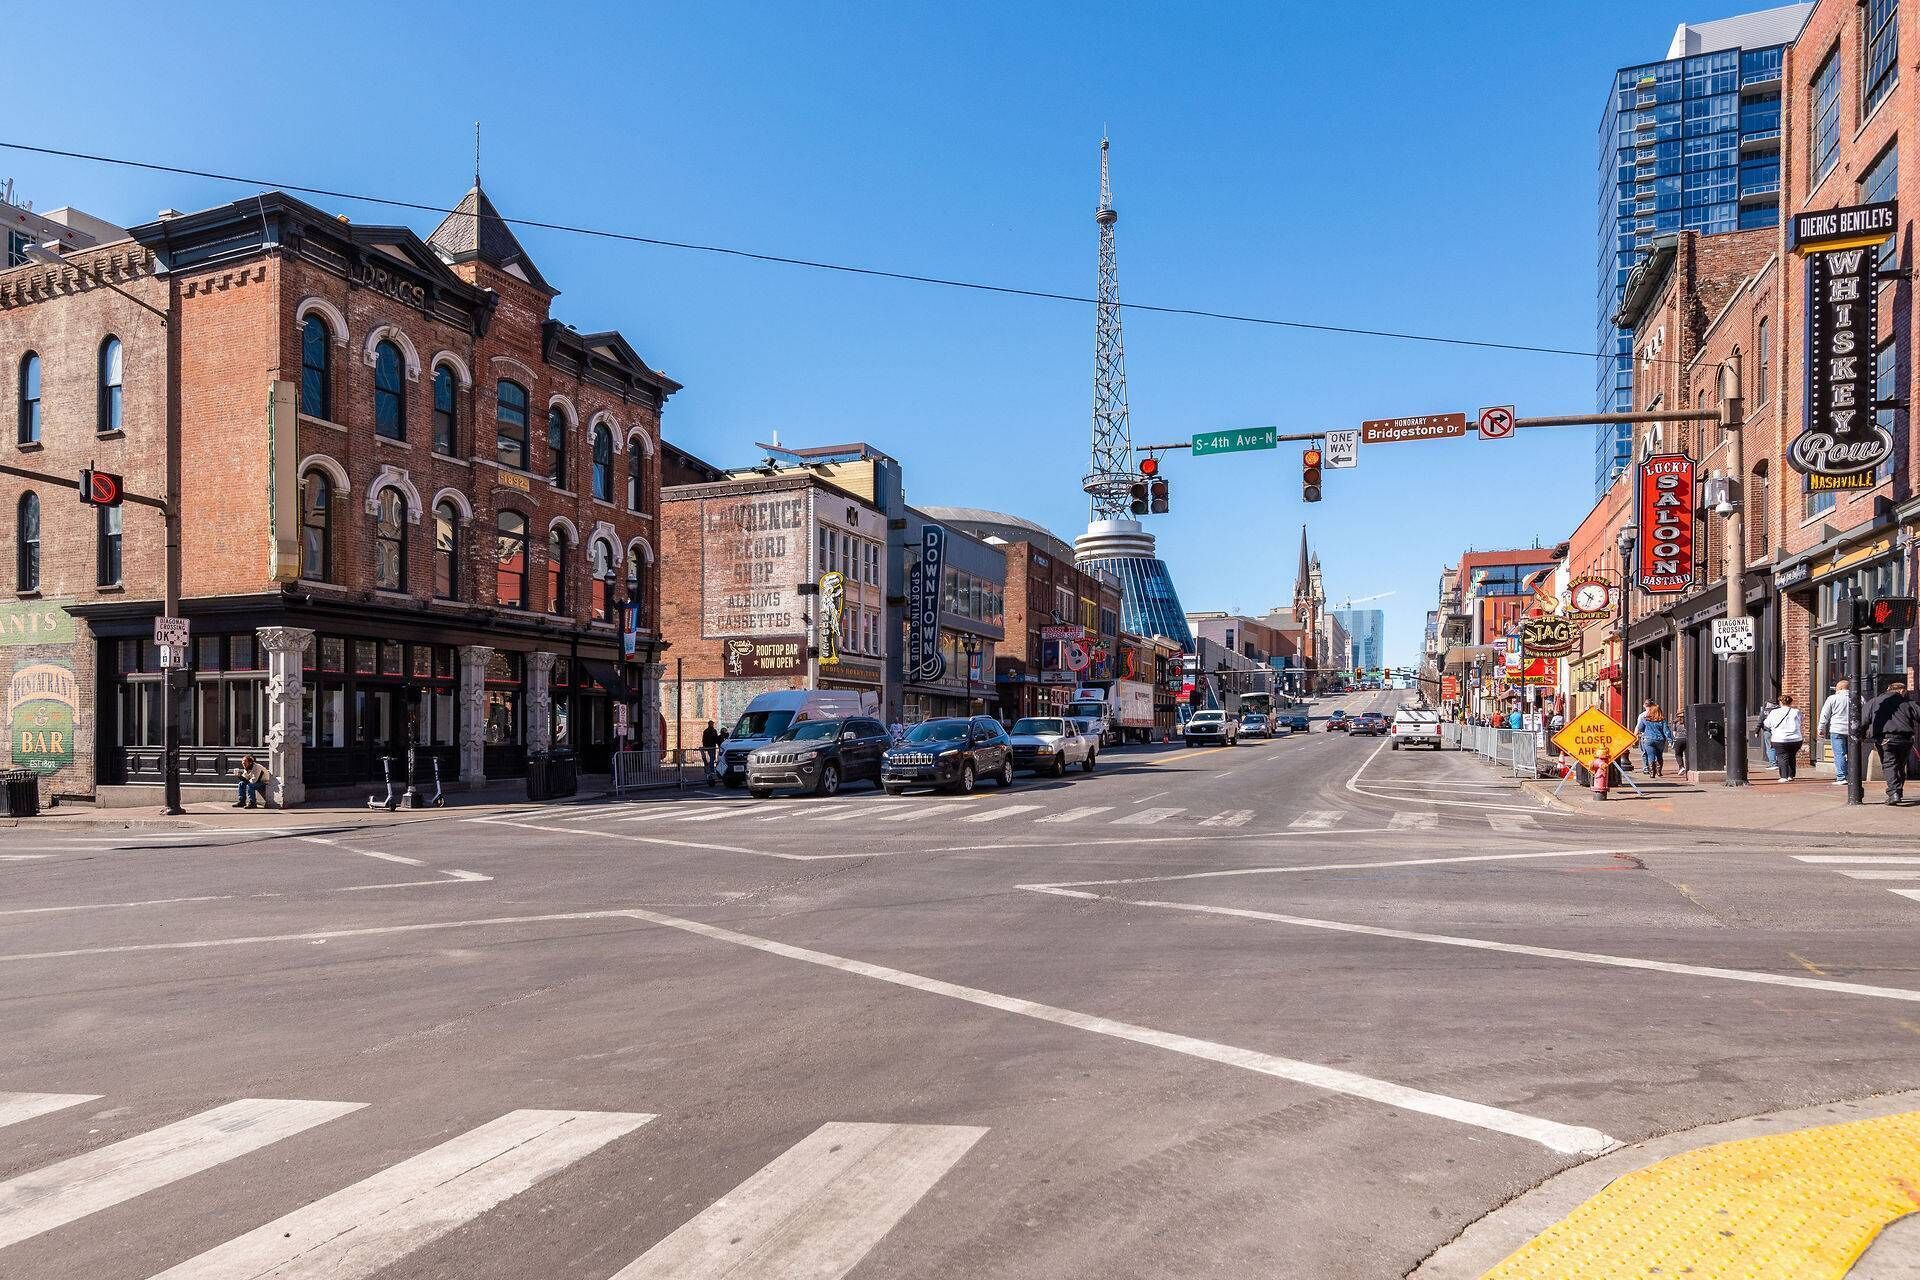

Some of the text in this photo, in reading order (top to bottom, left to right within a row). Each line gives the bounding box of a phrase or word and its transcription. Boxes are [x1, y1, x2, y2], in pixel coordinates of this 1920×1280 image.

[1800, 214, 1837, 237] DIERKS
[362, 256, 425, 308] DRUGS
[1826, 250, 1863, 433] WHISKEY
[1394, 417, 1427, 427] HONORARY
[1332, 433, 1352, 442] ONE
[1368, 425, 1459, 440] Bridgestone Dr
[1330, 443, 1353, 452] WAY
[1802, 433, 1884, 471] Row
[1645, 462, 1690, 476] LUCKY
[503, 474, 525, 488] 1892
[1810, 471, 1873, 489] NASHVILLE
[704, 499, 801, 532] LAWRENCE
[1654, 475, 1680, 574] SALOON
[724, 536, 786, 559] RECORD
[734, 562, 774, 583] SHOP
[1642, 574, 1690, 586] BASTARD
[728, 591, 781, 608] ALBUMS
[923, 532, 938, 656] DOWNTOWN
[717, 613, 792, 629] CASSETTES
[911, 571, 920, 661] SPORTING CLUB
[1718, 619, 1749, 627] DIAGONAL
[157, 631, 169, 641] OK
[1524, 622, 1579, 643] STAGE
[1718, 626, 1749, 634] CROSSING
[756, 645, 784, 656] ROOFTOP
[786, 644, 798, 654] BAR
[1715, 636, 1730, 648] OK
[761, 657, 794, 669] NOW OPEN
[33, 707, 49, 727] &
[1581, 725, 1605, 733] LANE
[21, 731, 64, 753] BAR
[1575, 736, 1612, 744] CLOSED
